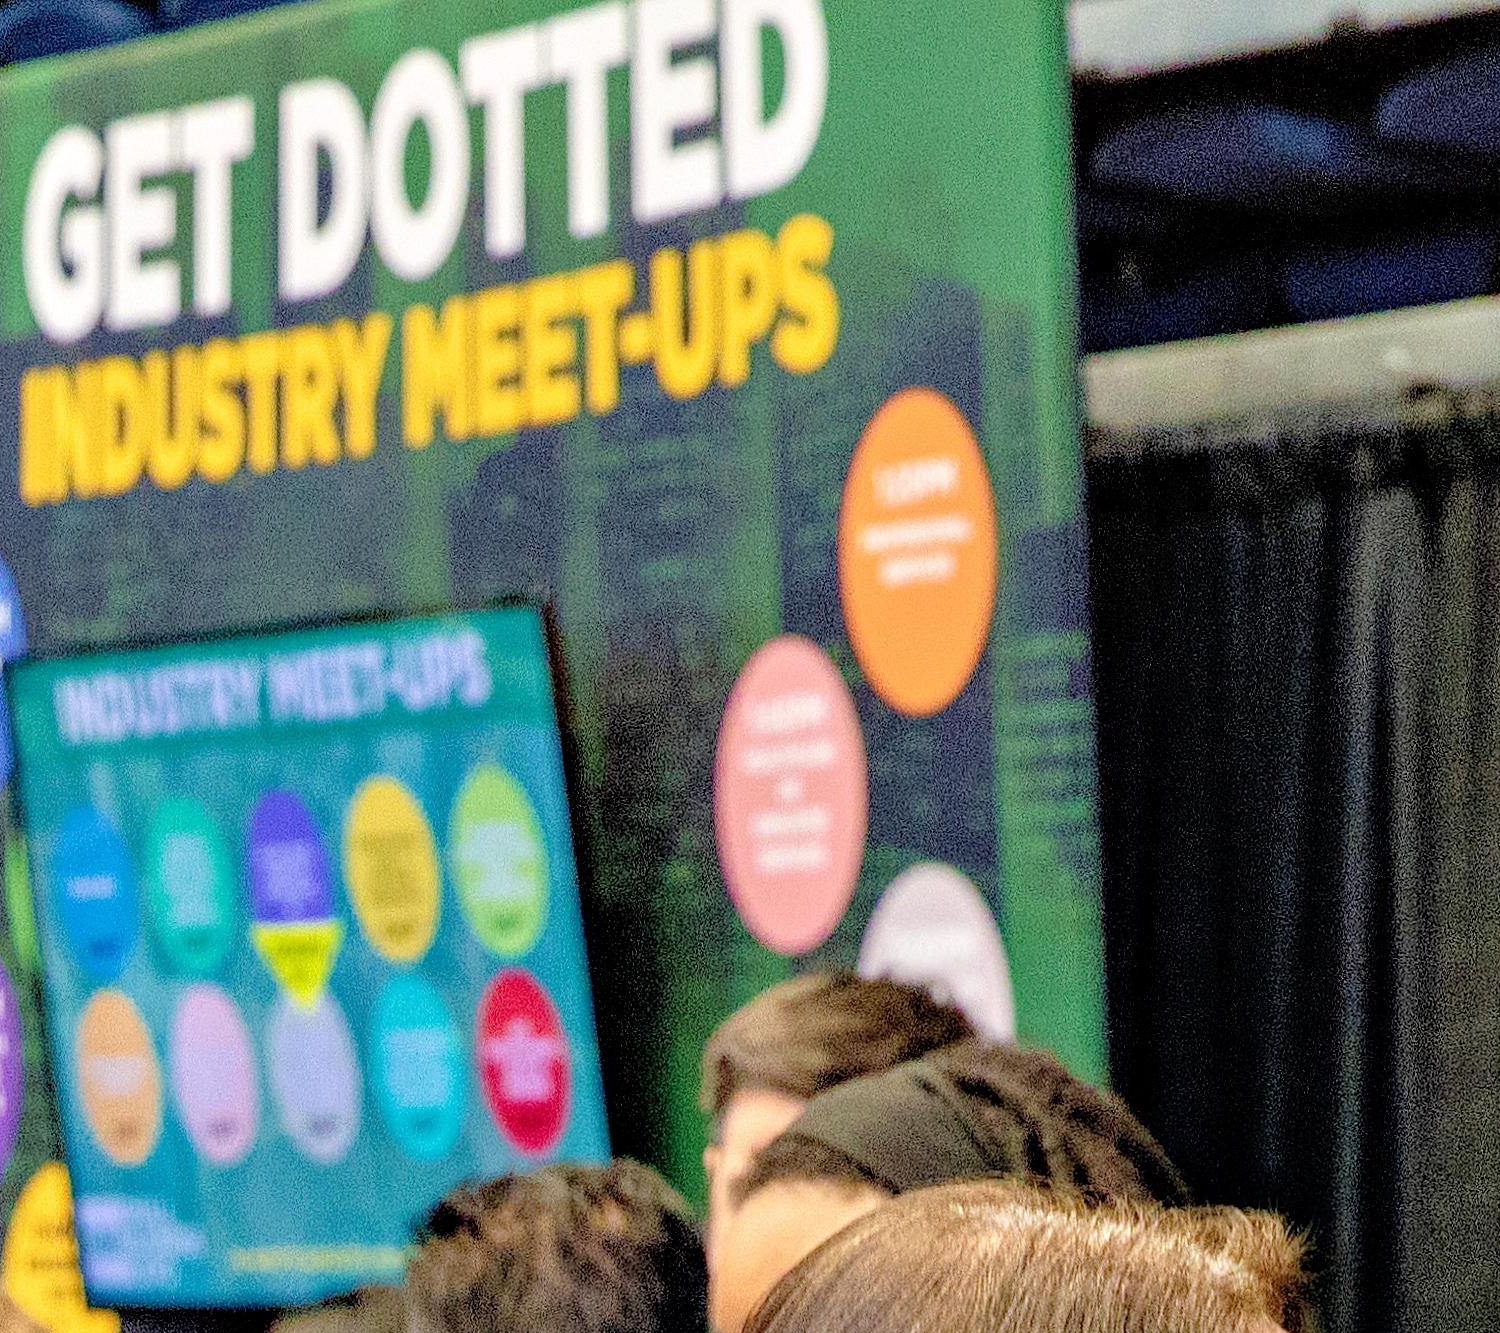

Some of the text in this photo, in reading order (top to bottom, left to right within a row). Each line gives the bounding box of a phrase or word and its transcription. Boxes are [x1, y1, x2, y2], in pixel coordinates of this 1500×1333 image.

[22, 0, 830, 344] GET DOTTED
[19, 213, 840, 506] INDUSTRY MEET-UPS
[53, 629, 493, 746] INDUSTRY MEET-UPS
